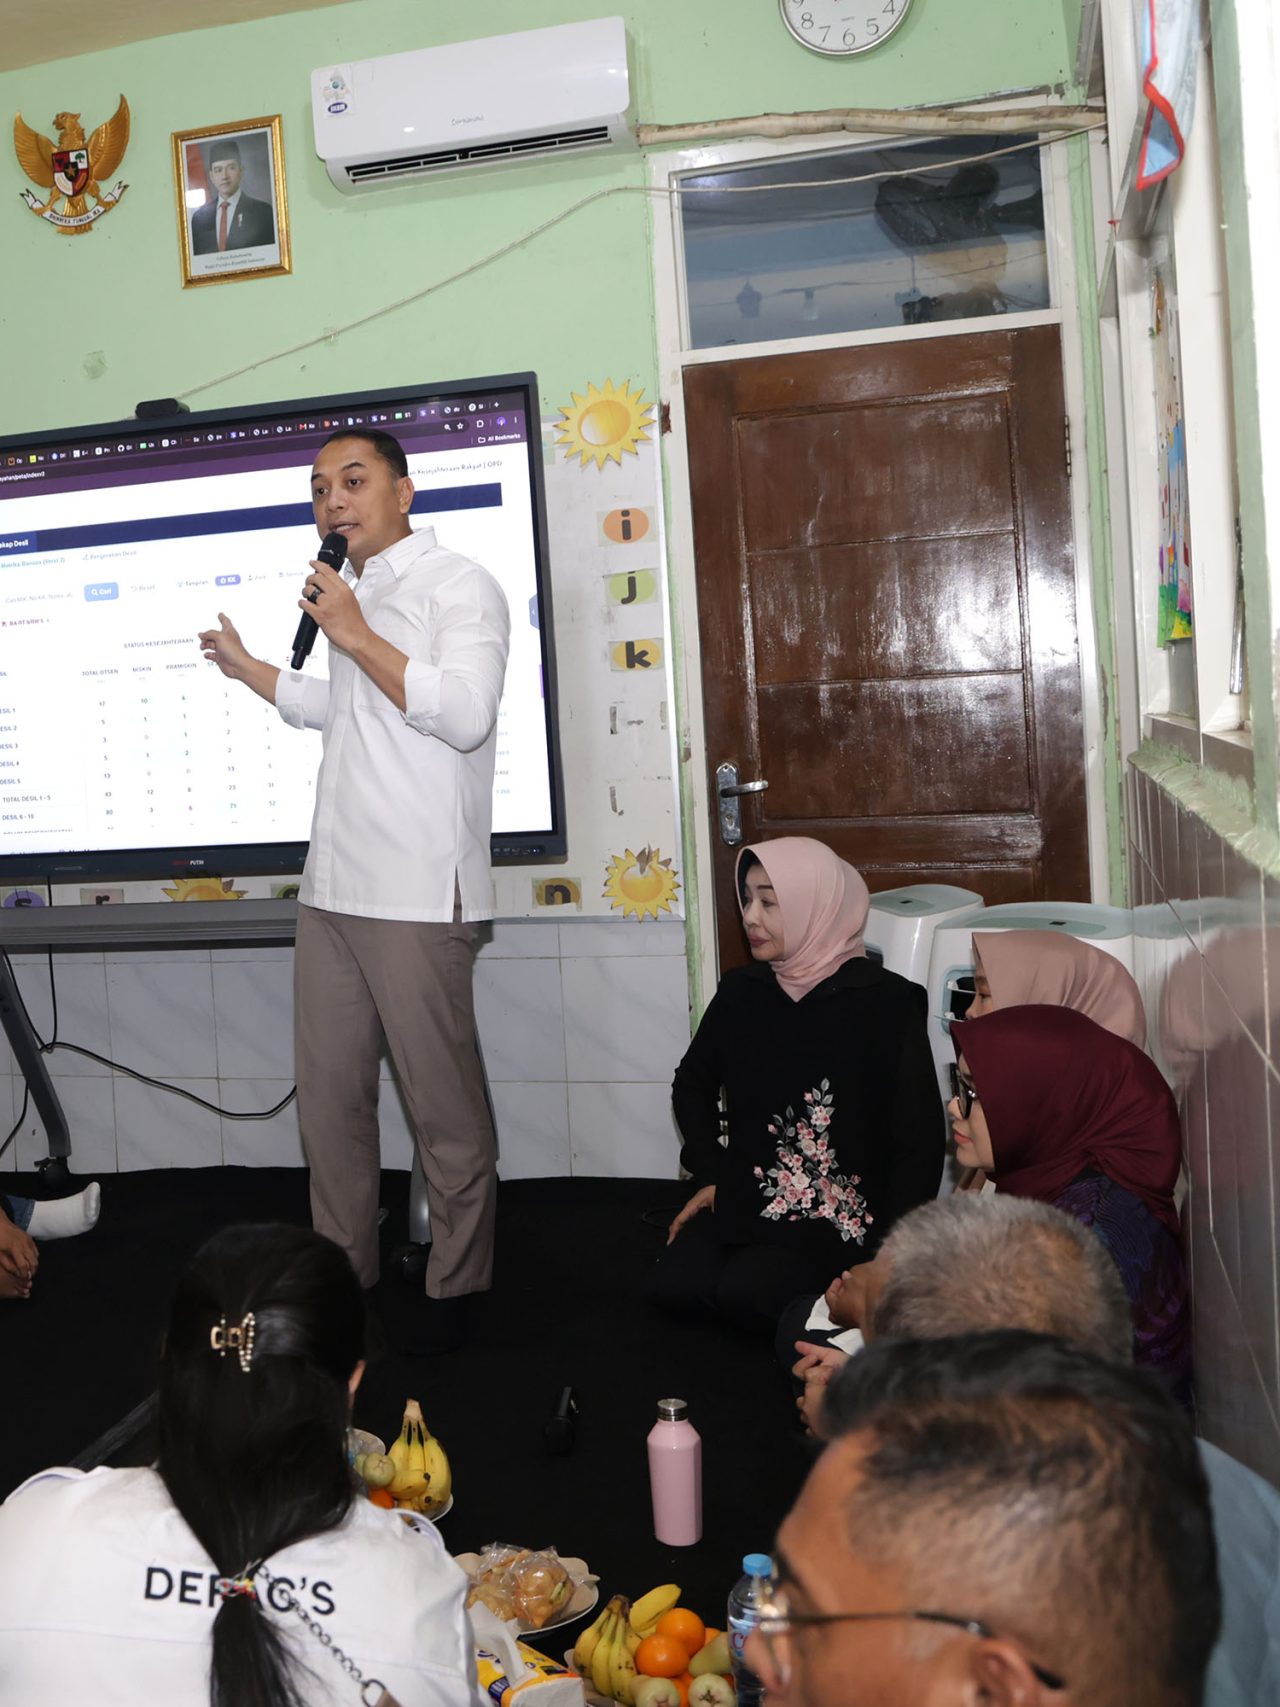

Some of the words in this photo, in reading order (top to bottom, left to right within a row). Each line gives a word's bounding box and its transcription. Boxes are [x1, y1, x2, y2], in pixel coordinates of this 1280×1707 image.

[882, 0, 896, 15] 4
[801, 12, 814, 30] 8
[866, 18, 879, 36] 5
[818, 25, 831, 43] 7
[842, 28, 856, 46] 6
[495, 433, 521, 441] Bookmarks
[621, 509, 631, 541] i
[13, 539, 29, 547] Desil
[621, 571, 637, 605] j
[123, 641, 145, 649] STATUS
[145, 638, 194, 647] KESEJAHTERAAN
[625, 640, 652, 669] k
[165, 662, 197, 670] PRAMISKIN
[545, 884, 571, 906] n
